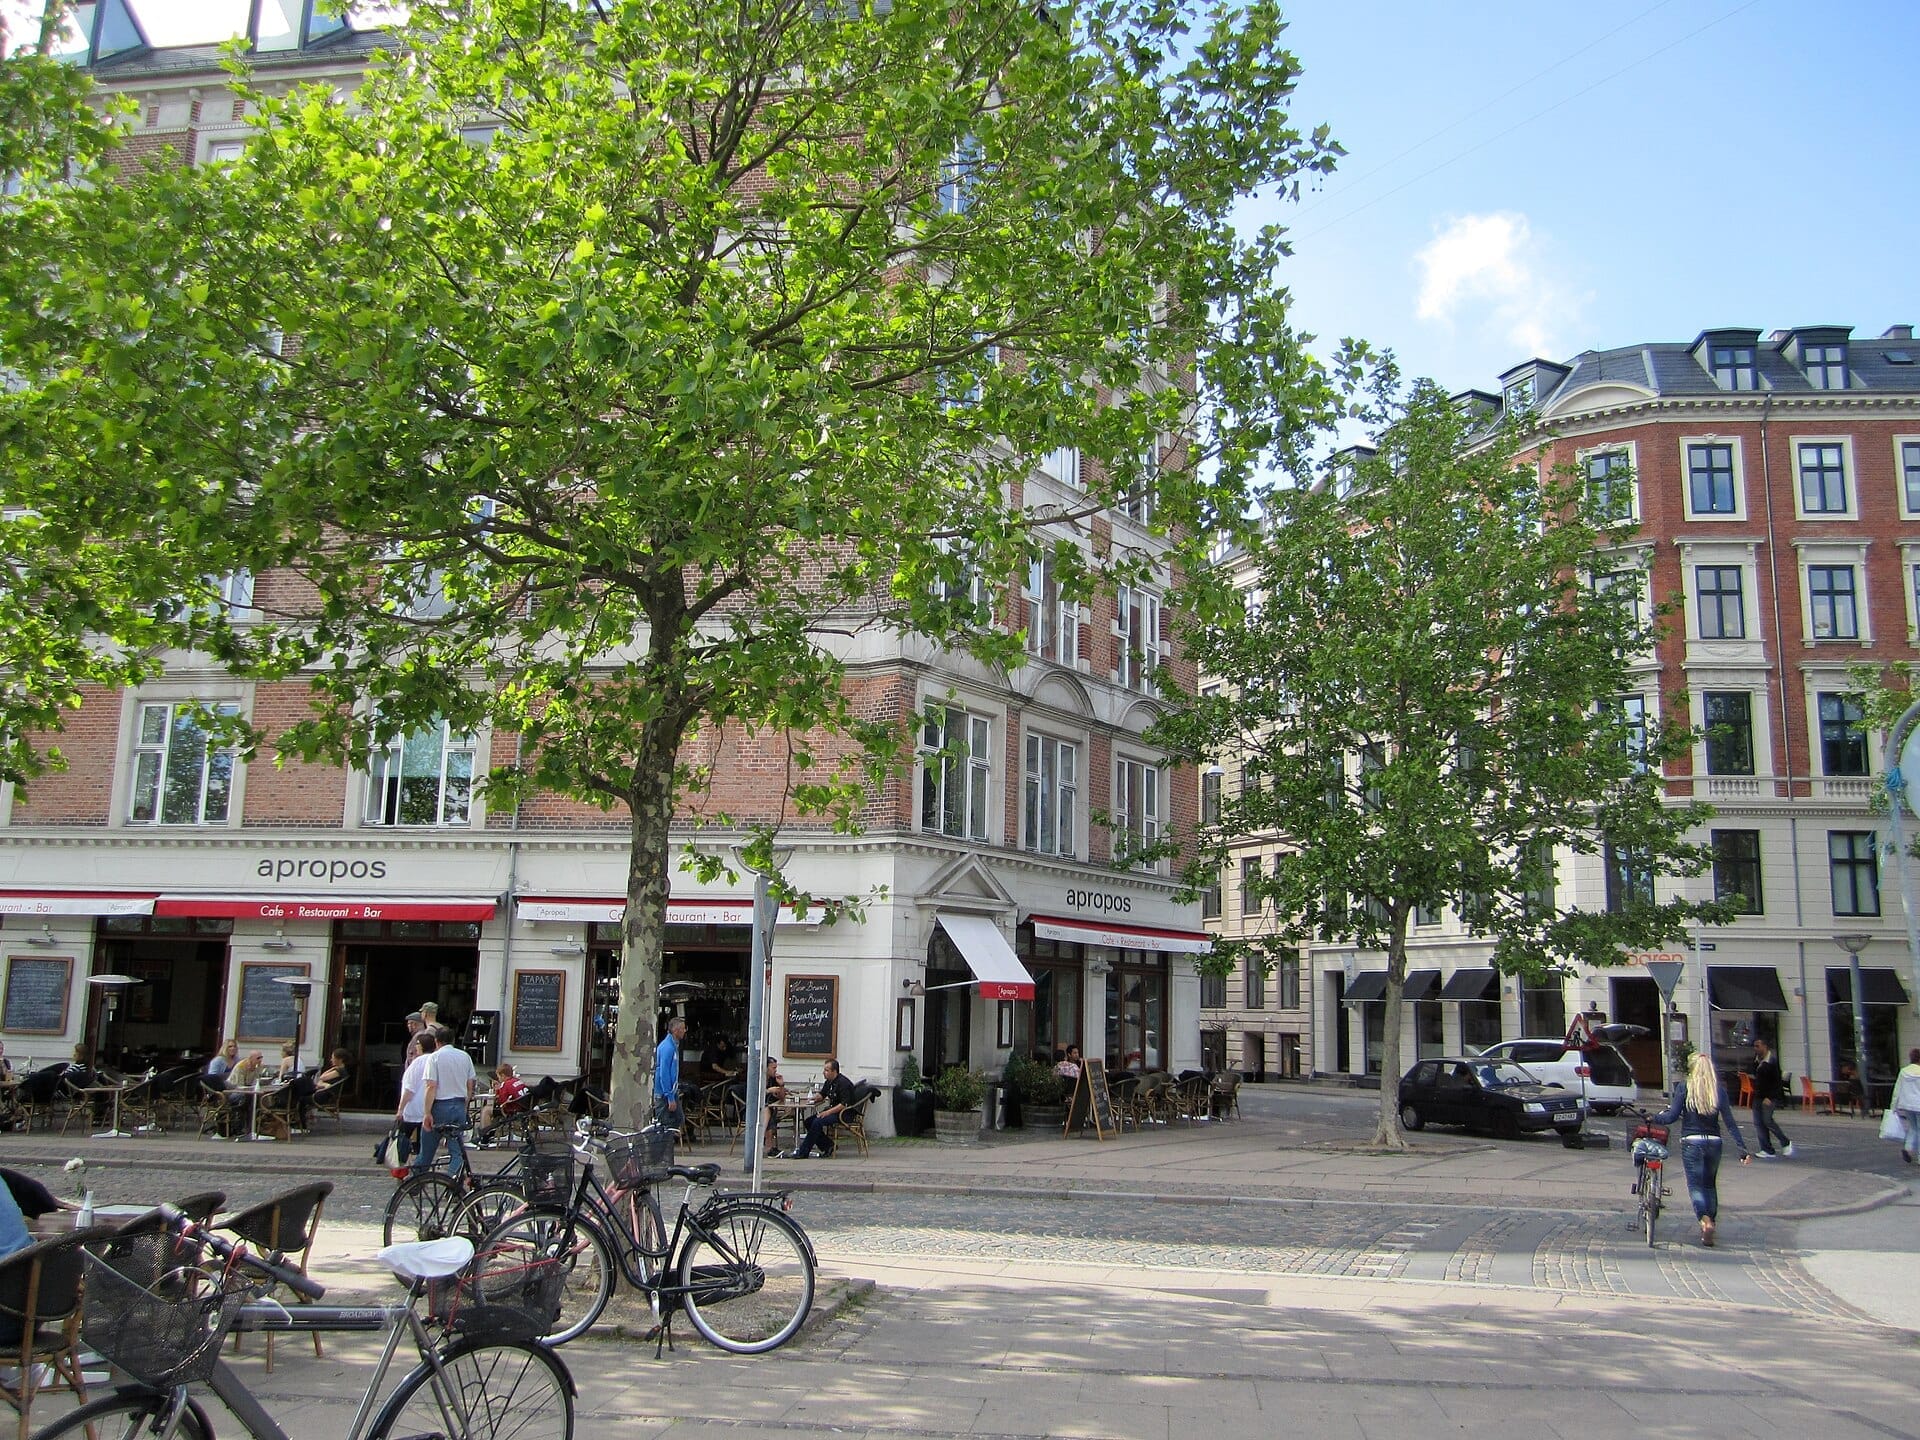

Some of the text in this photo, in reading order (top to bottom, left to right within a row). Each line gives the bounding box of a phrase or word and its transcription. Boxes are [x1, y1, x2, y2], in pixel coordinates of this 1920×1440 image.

[257, 859, 387, 883] apropos
[36, 902, 53, 913] Bar
[1066, 888, 1132, 914] apropos
[260, 905, 382, 918] Cafe Restaurant Bar
[723, 911, 742, 922] Bar
[1101, 934, 1115, 945] Cafe
[1120, 937, 1146, 948] Restaurant
[522, 975, 550, 985] TAPAS
